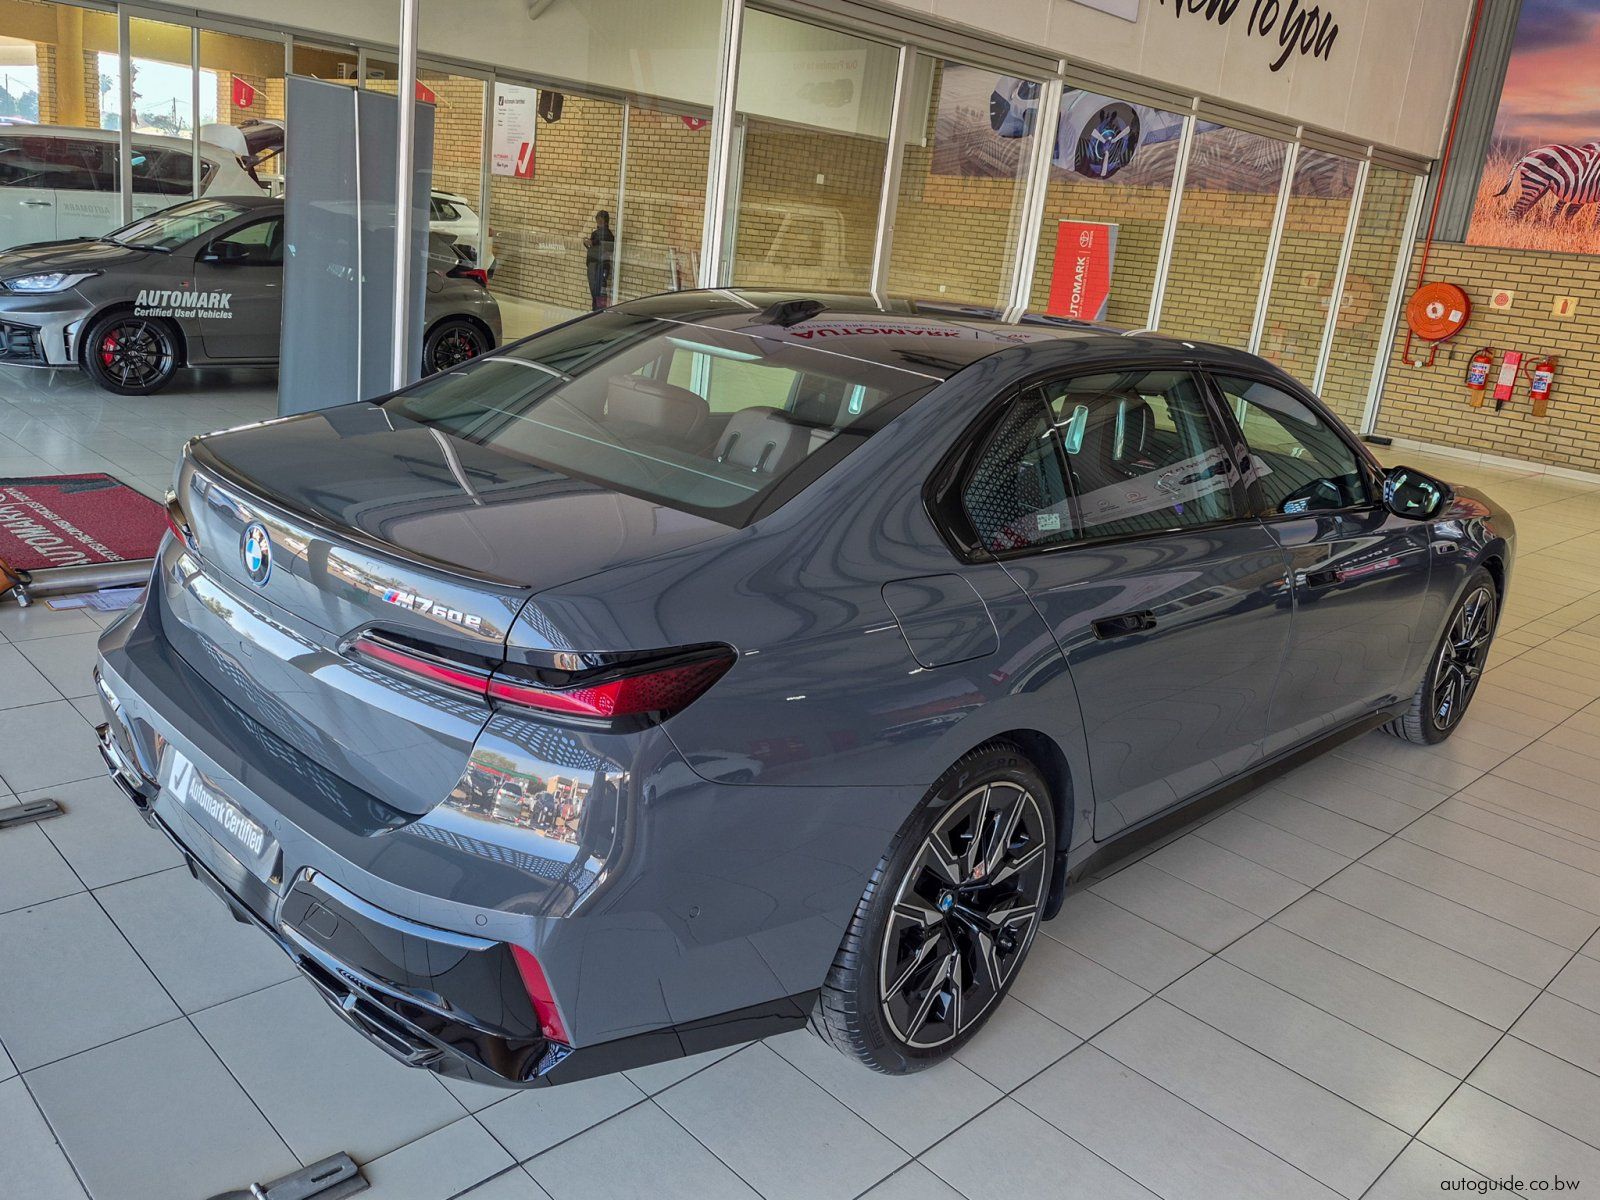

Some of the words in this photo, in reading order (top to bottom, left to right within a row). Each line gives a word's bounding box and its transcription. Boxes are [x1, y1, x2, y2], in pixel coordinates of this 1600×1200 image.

[1269, 0, 1339, 72] you
[134, 289, 233, 309] AUTOMARK
[134, 306, 172, 318] Certified
[174, 308, 196, 318] Used
[197, 309, 233, 319] Vehicles
[1069, 256, 1086, 318] UTOMARK
[188, 777, 226, 825] Automark
[223, 806, 265, 855] Certified
